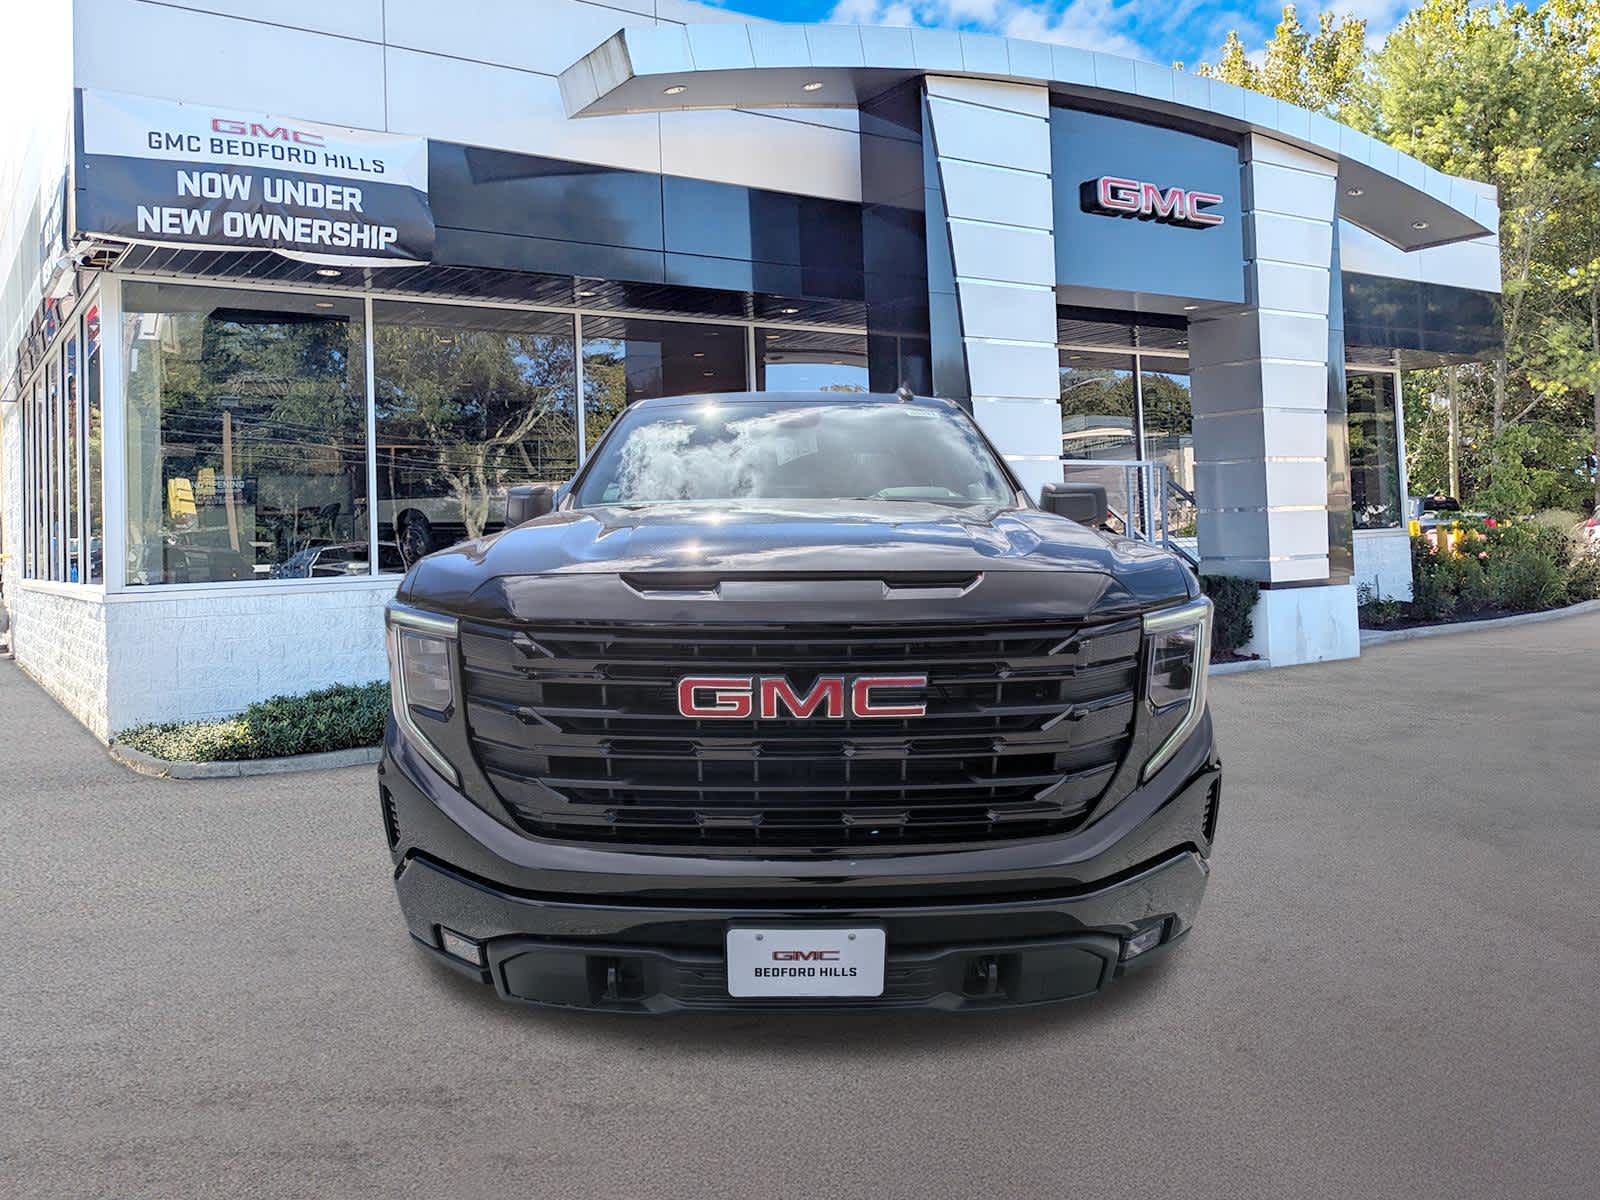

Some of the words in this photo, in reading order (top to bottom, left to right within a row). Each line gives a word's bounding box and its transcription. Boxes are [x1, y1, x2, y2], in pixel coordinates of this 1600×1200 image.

[148, 131, 201, 152] GMC
[210, 138, 317, 164] BEDFORD
[325, 153, 385, 174] HILLS
[211, 118, 325, 147] GMC
[177, 170, 252, 201] NOW
[263, 177, 363, 212] UNDER
[1098, 176, 1224, 224] GMC
[137, 205, 211, 236] NEW
[223, 211, 398, 250] OWNERSHIP
[678, 675, 928, 719] GMC
[754, 967, 816, 977] BEDFORD
[819, 967, 857, 977] HILLS
[772, 950, 840, 961] GMC
